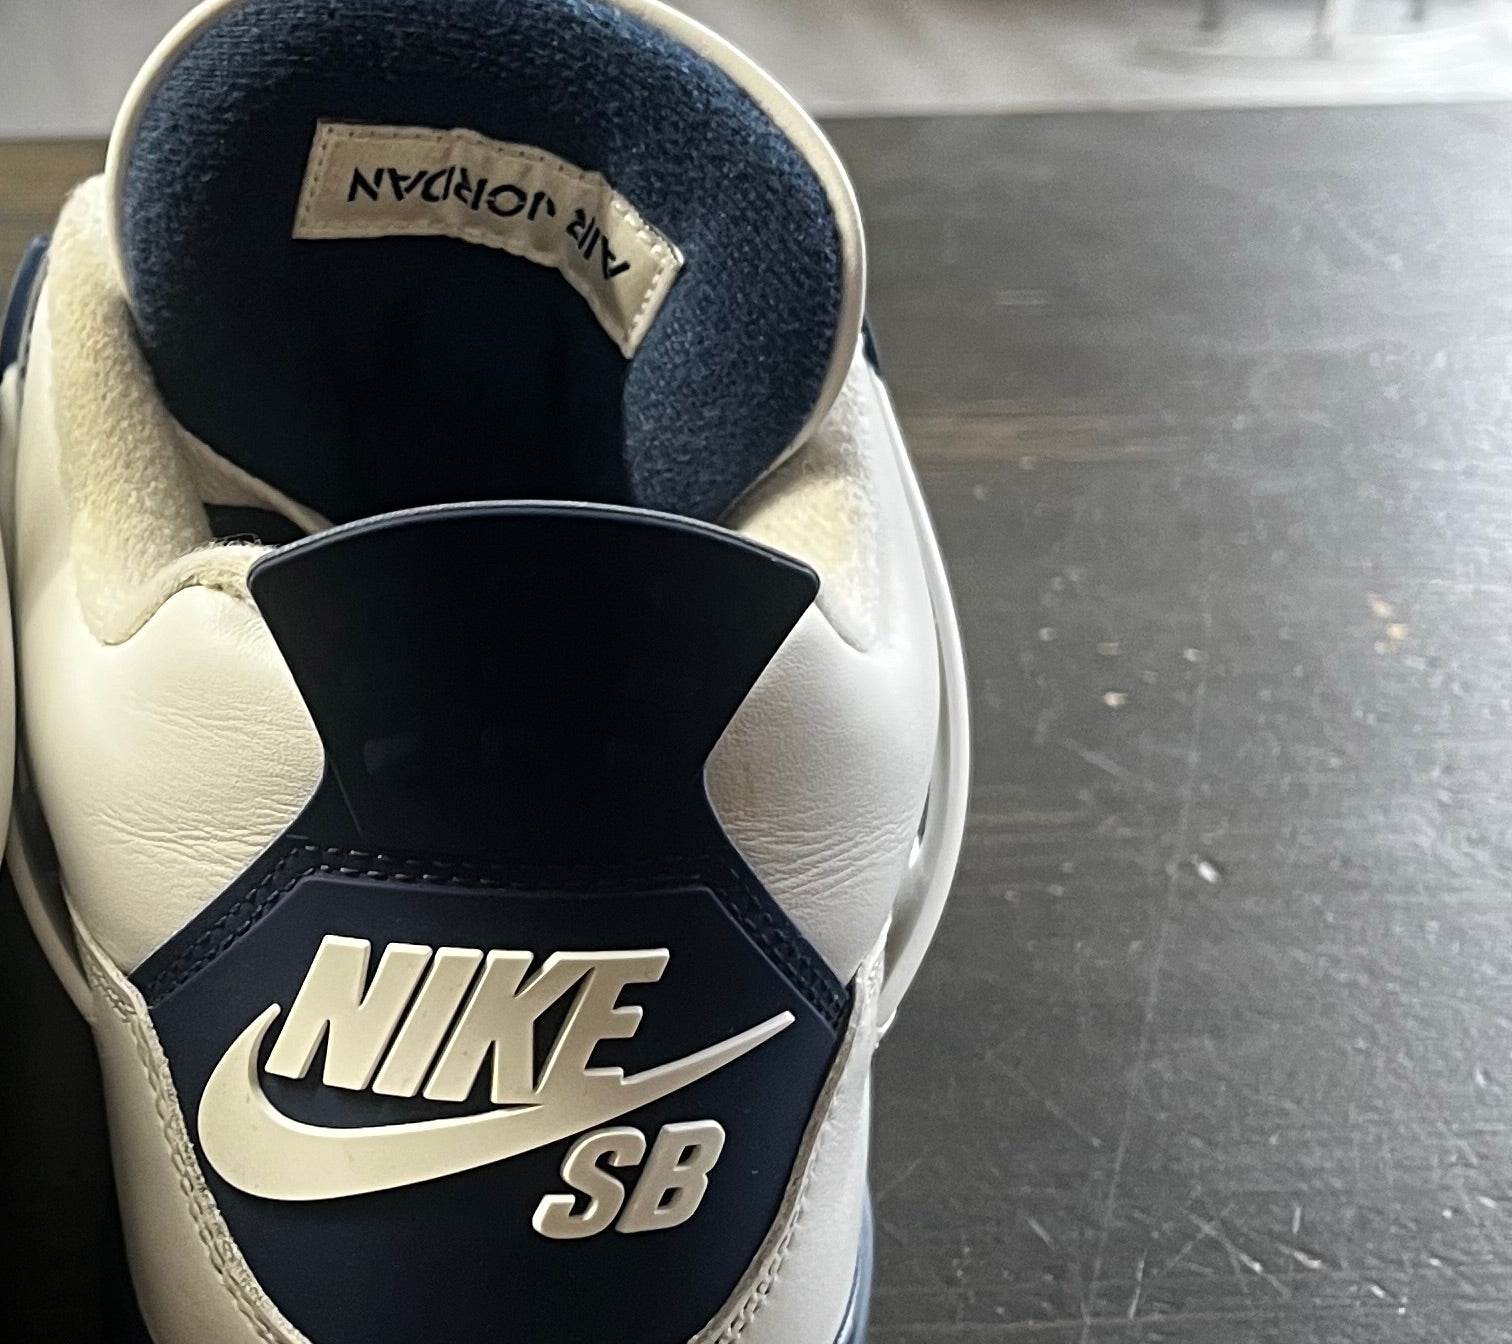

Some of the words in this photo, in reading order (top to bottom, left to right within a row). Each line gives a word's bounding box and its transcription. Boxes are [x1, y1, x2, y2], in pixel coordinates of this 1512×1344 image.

[346, 166, 555, 221] JORDAN
[566, 208, 631, 280] AIR
[264, 934, 670, 1105] NIKE
[532, 1119, 725, 1240] SB
